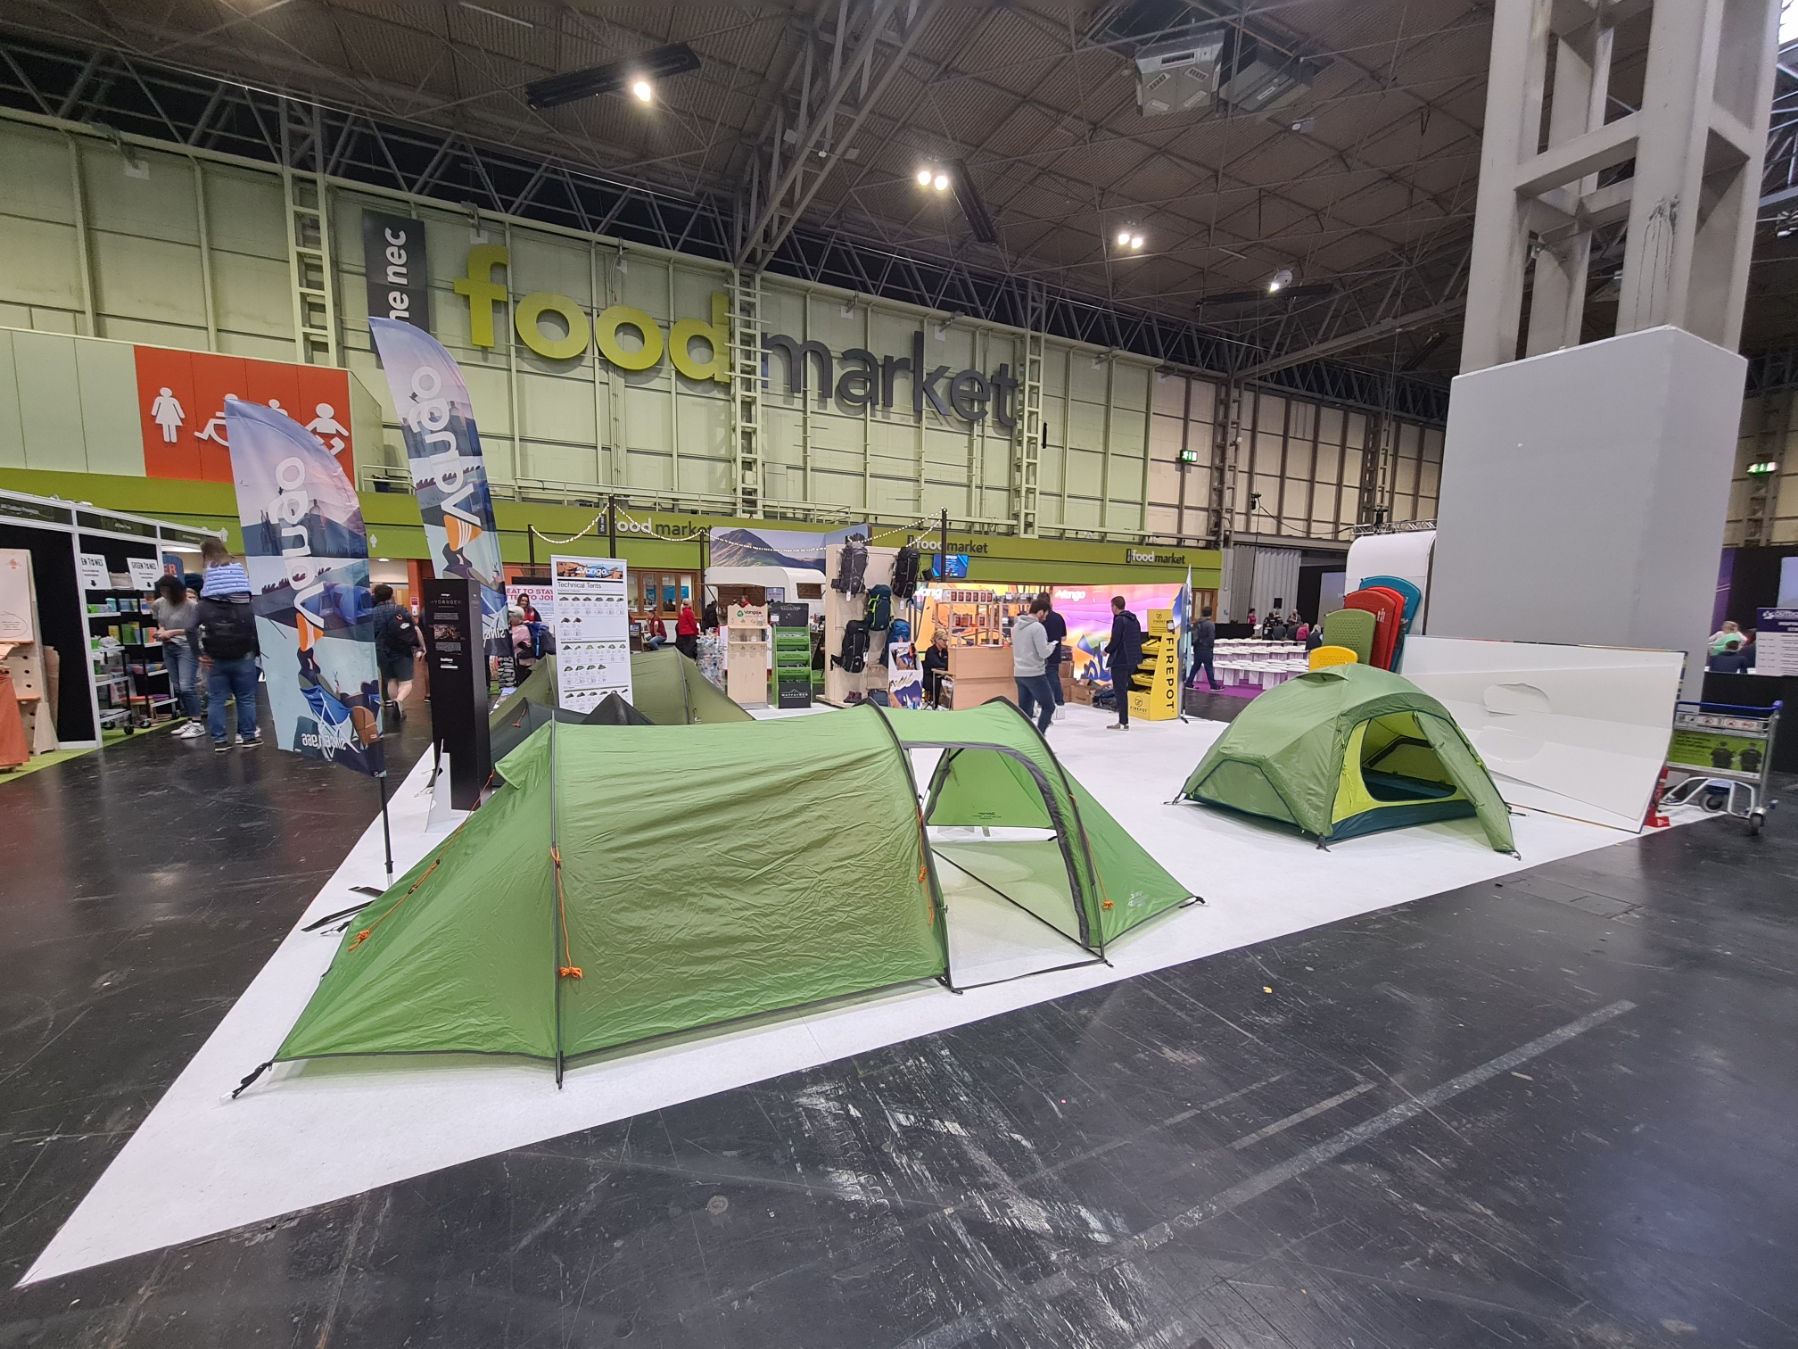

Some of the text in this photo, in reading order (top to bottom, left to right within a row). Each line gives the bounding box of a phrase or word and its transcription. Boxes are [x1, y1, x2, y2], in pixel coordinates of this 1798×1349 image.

[384, 226, 408, 286] nec
[454, 244, 1019, 428] food market
[616, 517, 652, 533] ood
[946, 540, 988, 553] market
[1132, 549, 1155, 562] food
[1155, 552, 1186, 564] market
[581, 566, 606, 577] Vango
[557, 581, 585, 589] Technical
[1059, 589, 1086, 602] Vango
[1165, 637, 1175, 710] FIREPOT
